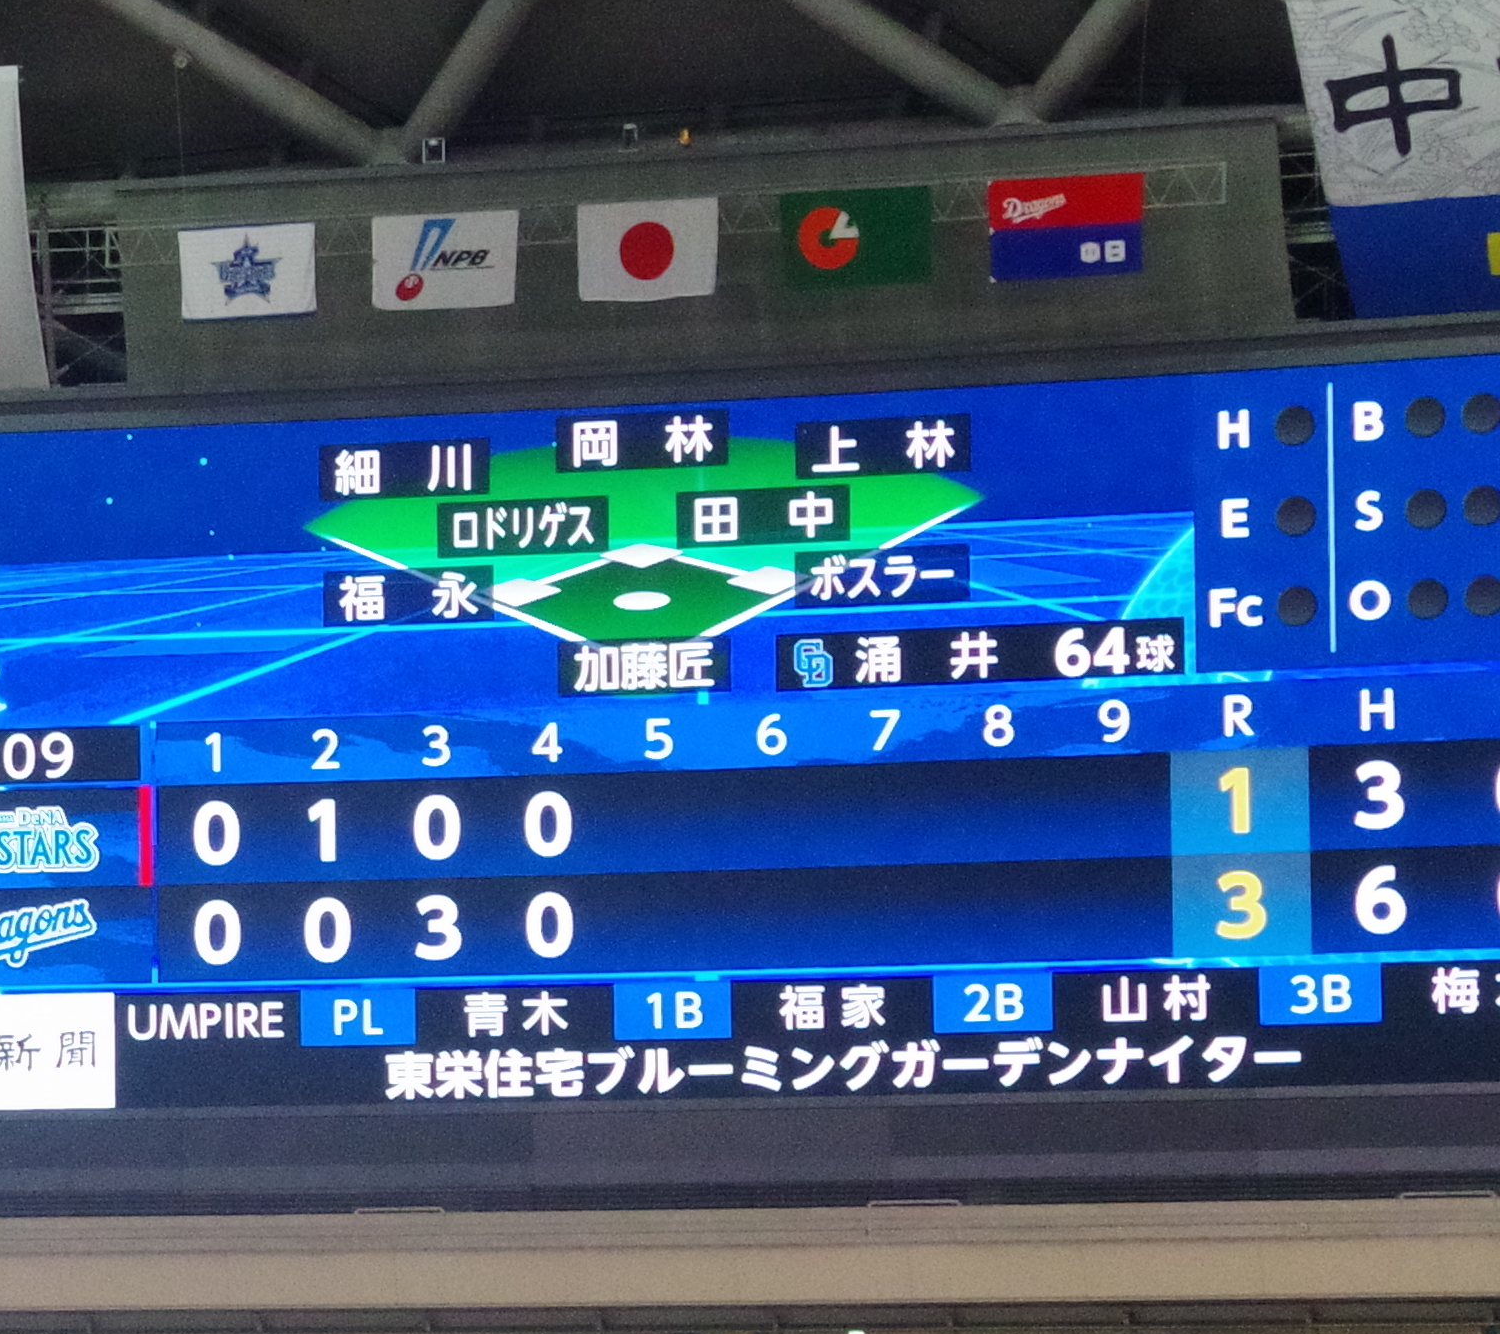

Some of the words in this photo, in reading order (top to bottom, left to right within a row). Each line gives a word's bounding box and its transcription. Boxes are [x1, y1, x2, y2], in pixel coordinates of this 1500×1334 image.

[431, 249, 490, 266] NPB
[572, 414, 714, 469] 岡林
[810, 419, 956, 474] 上林
[1217, 408, 1251, 451] H
[1352, 400, 1385, 442] B
[333, 442, 473, 497] 細川
[452, 501, 596, 551] ロドリゲス
[693, 490, 835, 543] 田中
[1220, 497, 1251, 539] E
[1354, 489, 1384, 532] S
[338, 570, 479, 621] 福永
[810, 555, 955, 600] ボスラー
[1348, 579, 1392, 622] O
[1208, 587, 1264, 629] Fc
[573, 641, 716, 693] 加藤匠
[854, 630, 1000, 684] 涌井
[204, 731, 222, 773] 1
[310, 727, 341, 771] 2
[421, 724, 452, 768] 3
[530, 721, 564, 764] 4
[644, 717, 674, 761] 5
[756, 712, 788, 756] 6
[869, 708, 901, 752] 7
[982, 703, 1015, 748] 8
[1097, 698, 1131, 744] 9
[1222, 693, 1255, 738] R
[1359, 687, 1396, 732] H
[18, 809, 64, 826] DeNA
[192, 799, 241, 867] 0
[307, 797, 337, 863] 1
[412, 793, 462, 861] 0
[523, 790, 573, 858] 0
[1217, 766, 1251, 835] 1
[1353, 759, 1406, 831] 3
[192, 898, 242, 966] 0
[302, 896, 353, 964] 0
[414, 893, 463, 962] 3
[524, 890, 575, 959] 0
[1216, 870, 1267, 940] 3
[1354, 864, 1408, 935] 6
[126, 1000, 286, 1042] UMPIRE
[333, 998, 385, 1037] PL
[462, 989, 570, 1039] 青木
[646, 990, 704, 1030] 1B
[777, 982, 887, 1031] 福家
[963, 982, 1025, 1023] 2B
[1101, 973, 1212, 1023] 山村
[1289, 973, 1353, 1015] 3B
[384, 1035, 1303, 1101] 東栄住宅ブルーミングガーデンナイター
